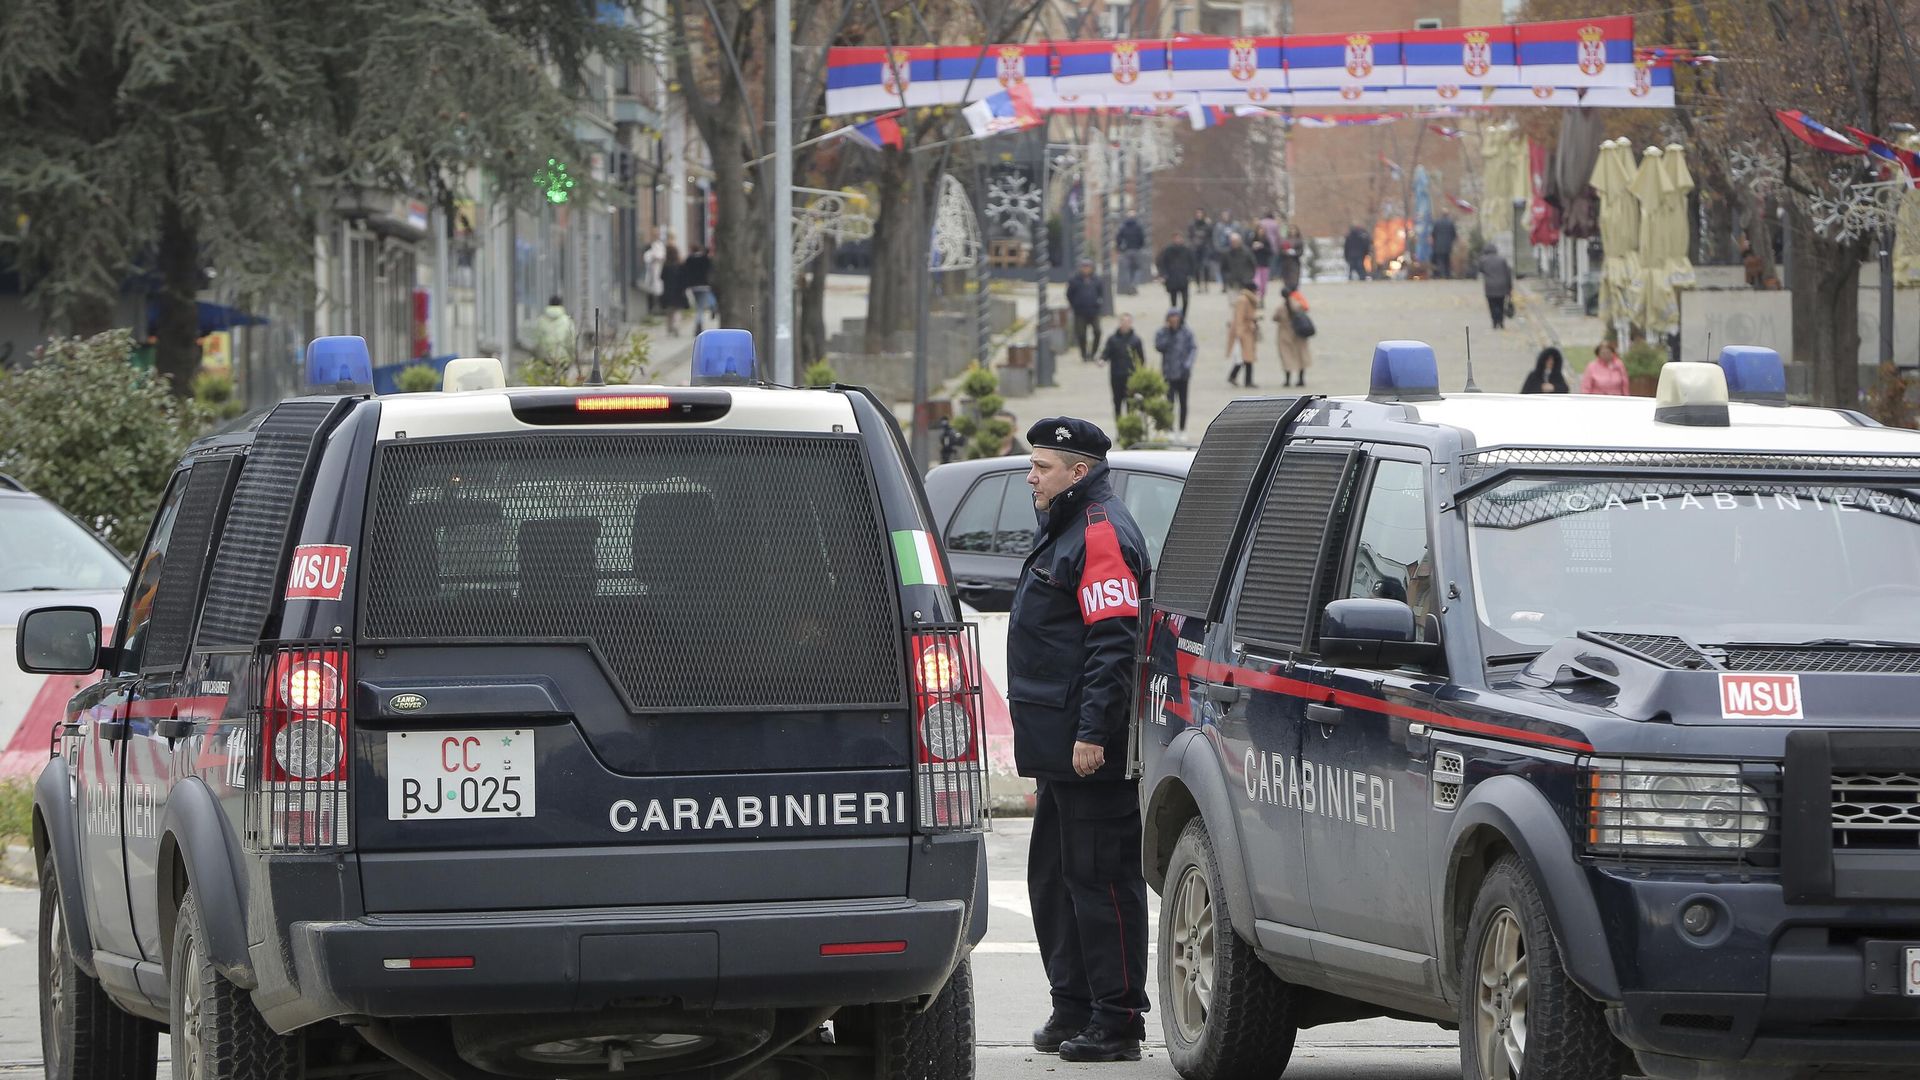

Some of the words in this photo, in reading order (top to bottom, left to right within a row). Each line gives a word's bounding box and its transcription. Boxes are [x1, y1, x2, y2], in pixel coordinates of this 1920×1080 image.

[1564, 491, 1919, 515] CARABINIERI
[289, 554, 341, 590] MSU
[1082, 578, 1139, 617] MSU
[1150, 674, 1168, 726] 112
[1727, 681, 1795, 712] MSU
[441, 736, 481, 773] CC
[1244, 746, 1396, 833] CARABINIERI
[86, 782, 157, 839] CARABINIERI
[608, 791, 906, 833] CARABINIERI
